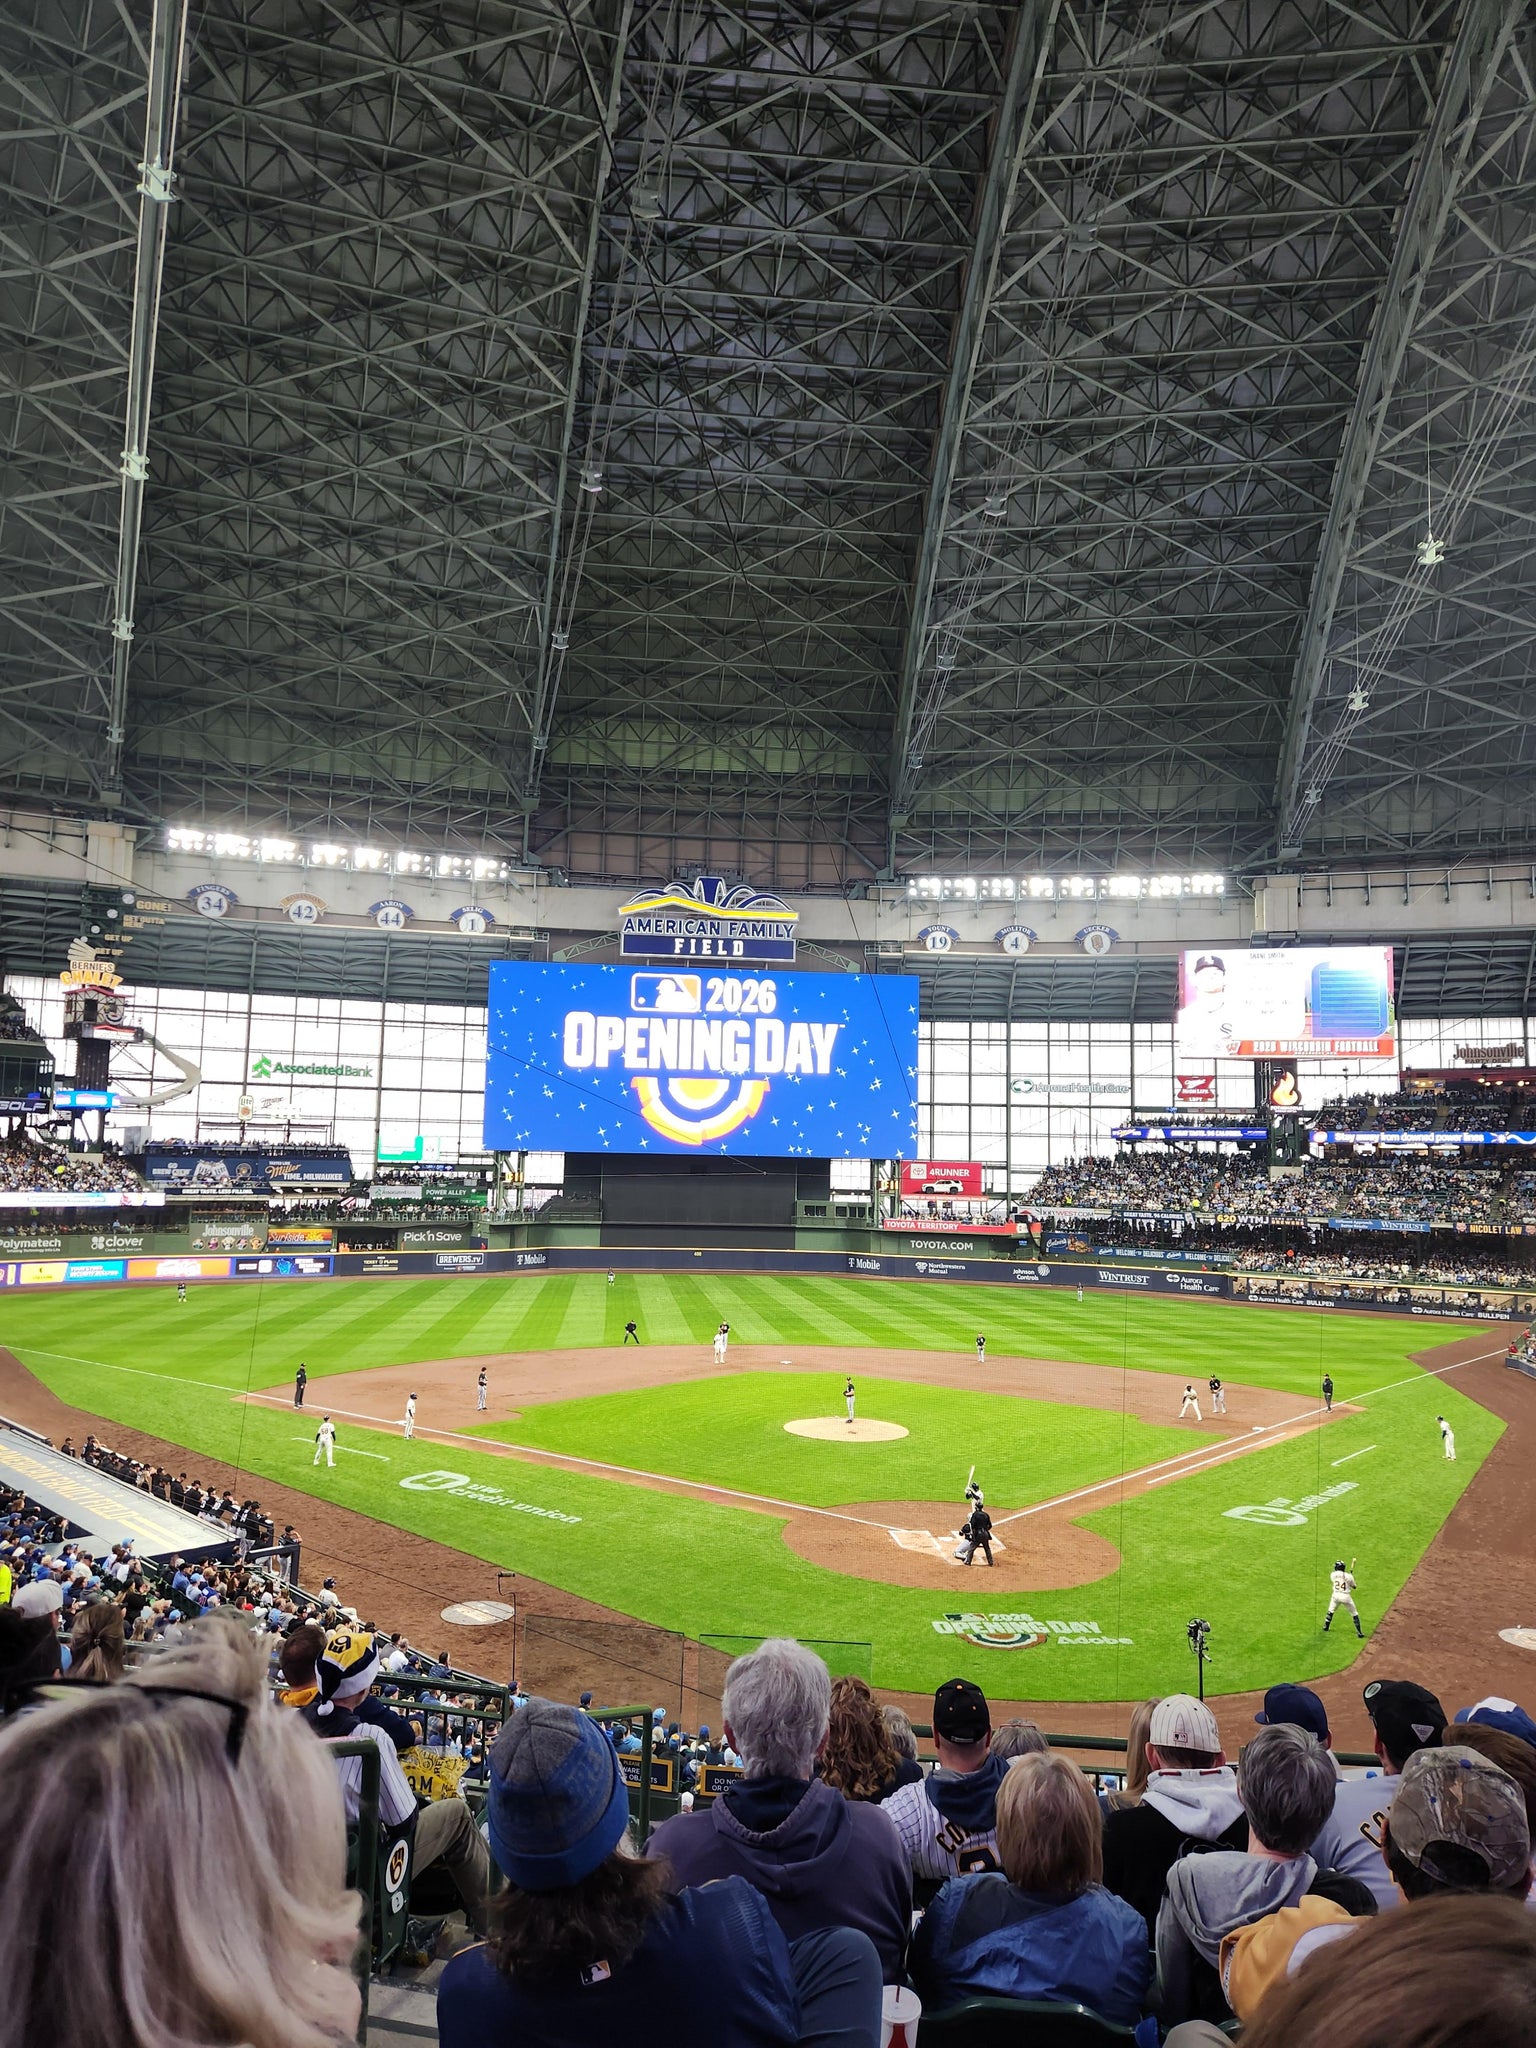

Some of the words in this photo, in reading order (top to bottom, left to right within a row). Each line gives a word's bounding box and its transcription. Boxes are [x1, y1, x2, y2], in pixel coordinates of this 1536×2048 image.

[196, 885, 231, 897] FINGERS
[136, 900, 172, 912] GONE!
[201, 896, 223, 912] 34
[379, 901, 404, 909] AARON
[292, 904, 313, 919] 42
[462, 906, 484, 914] SELIG
[380, 912, 401, 926] 44
[468, 918, 476, 932] 1
[624, 918, 720, 936] AMERICAN
[729, 922, 794, 938] FAMILY
[927, 925, 950, 933] YOUNT
[1083, 926, 1111, 934] UECKER
[1001, 926, 1031, 936] MOLITOR
[674, 938, 744, 956] FIELD
[929, 935, 948, 949] 19
[1010, 936, 1019, 949] 4
[71, 961, 114, 972] BERNIE'S
[60, 971, 124, 990] CHALET
[705, 977, 777, 1014] 2026
[563, 1011, 751, 1072] OPENING
[754, 1018, 839, 1074] DAY
[1453, 1043, 1525, 1060] Johnsonville
[1105, 1083, 1130, 1093] Care
[1334, 1132, 1355, 1142] Stay
[1355, 1134, 1380, 1143] away
[1380, 1132, 1401, 1141] from
[1401, 1132, 1434, 1141] downed
[1435, 1134, 1462, 1143] power
[1462, 1132, 1485, 1141] lines
[265, 1164, 301, 1180] Miller
[303, 1173, 343, 1181] MILWAUKEE
[929, 1167, 970, 1177] 4RUNNER
[1216, 1214, 1237, 1223] 620
[1237, 1215, 1269, 1224] WTMJ
[202, 1224, 254, 1237] Johnsonville
[886, 1221, 916, 1230] TOYOTA
[917, 1222, 959, 1231] TERRITORY
[1380, 1220, 1426, 1231] WINTRUST
[1469, 1224, 1502, 1234] NICOLET
[1505, 1225, 1522, 1234] LAW
[105, 1236, 143, 1247] clover
[269, 1232, 305, 1244] Surfside
[404, 1231, 426, 1242] Pick
[435, 1231, 462, 1242] Save
[0, 1239, 61, 1250] Polymatech
[910, 1240, 973, 1251] TOYOTA.COM
[524, 1254, 547, 1265] Mobile
[1116, 1249, 1136, 1257] WELCOME
[1143, 1250, 1164, 1259] DELICIOUS
[1185, 1252, 1206, 1261] WELCOME
[856, 1258, 880, 1270] Mobile
[1013, 1268, 1035, 1276] Johnson
[1099, 1271, 1150, 1283] WINTRUST
[1180, 1283, 1203, 1291] Health
[1306, 1299, 1335, 1307] BULLPEN
[1478, 1312, 1510, 1320] BULLPEN
[1334, 1580, 1346, 1591] 24
[991, 1613, 1034, 1622] 2026
[931, 1621, 1050, 1634] OPENING
[1047, 1620, 1102, 1634] DAY
[711, 1784, 722, 1792] OR
